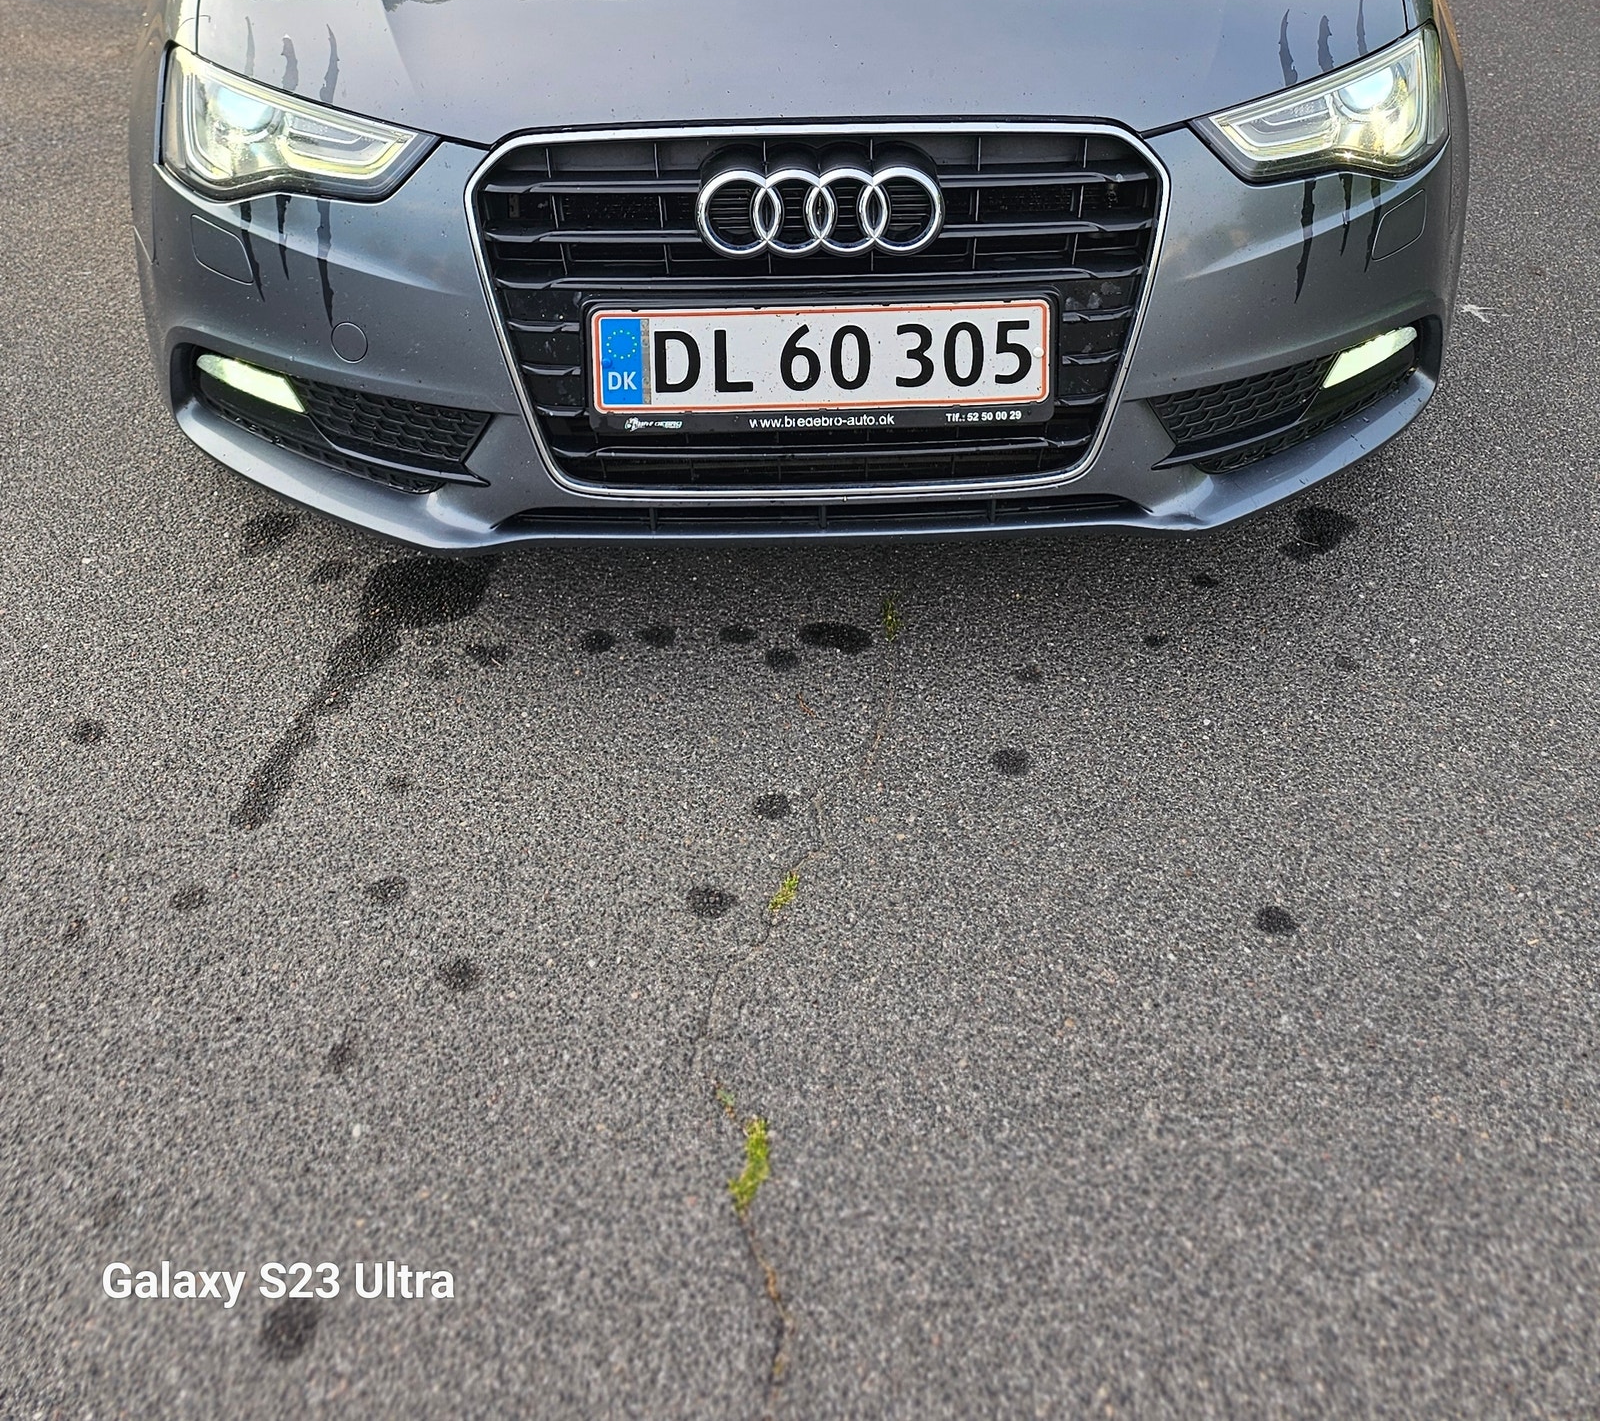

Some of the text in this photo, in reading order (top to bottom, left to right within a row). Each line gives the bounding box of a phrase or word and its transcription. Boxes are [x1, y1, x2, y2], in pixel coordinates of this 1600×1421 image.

[654, 320, 1032, 393] DL 60 305
[607, 372, 637, 390] DK
[966, 412, 979, 422] 52
[981, 411, 994, 421] 50
[996, 411, 1008, 421] 00
[1009, 410, 1022, 420] 29
